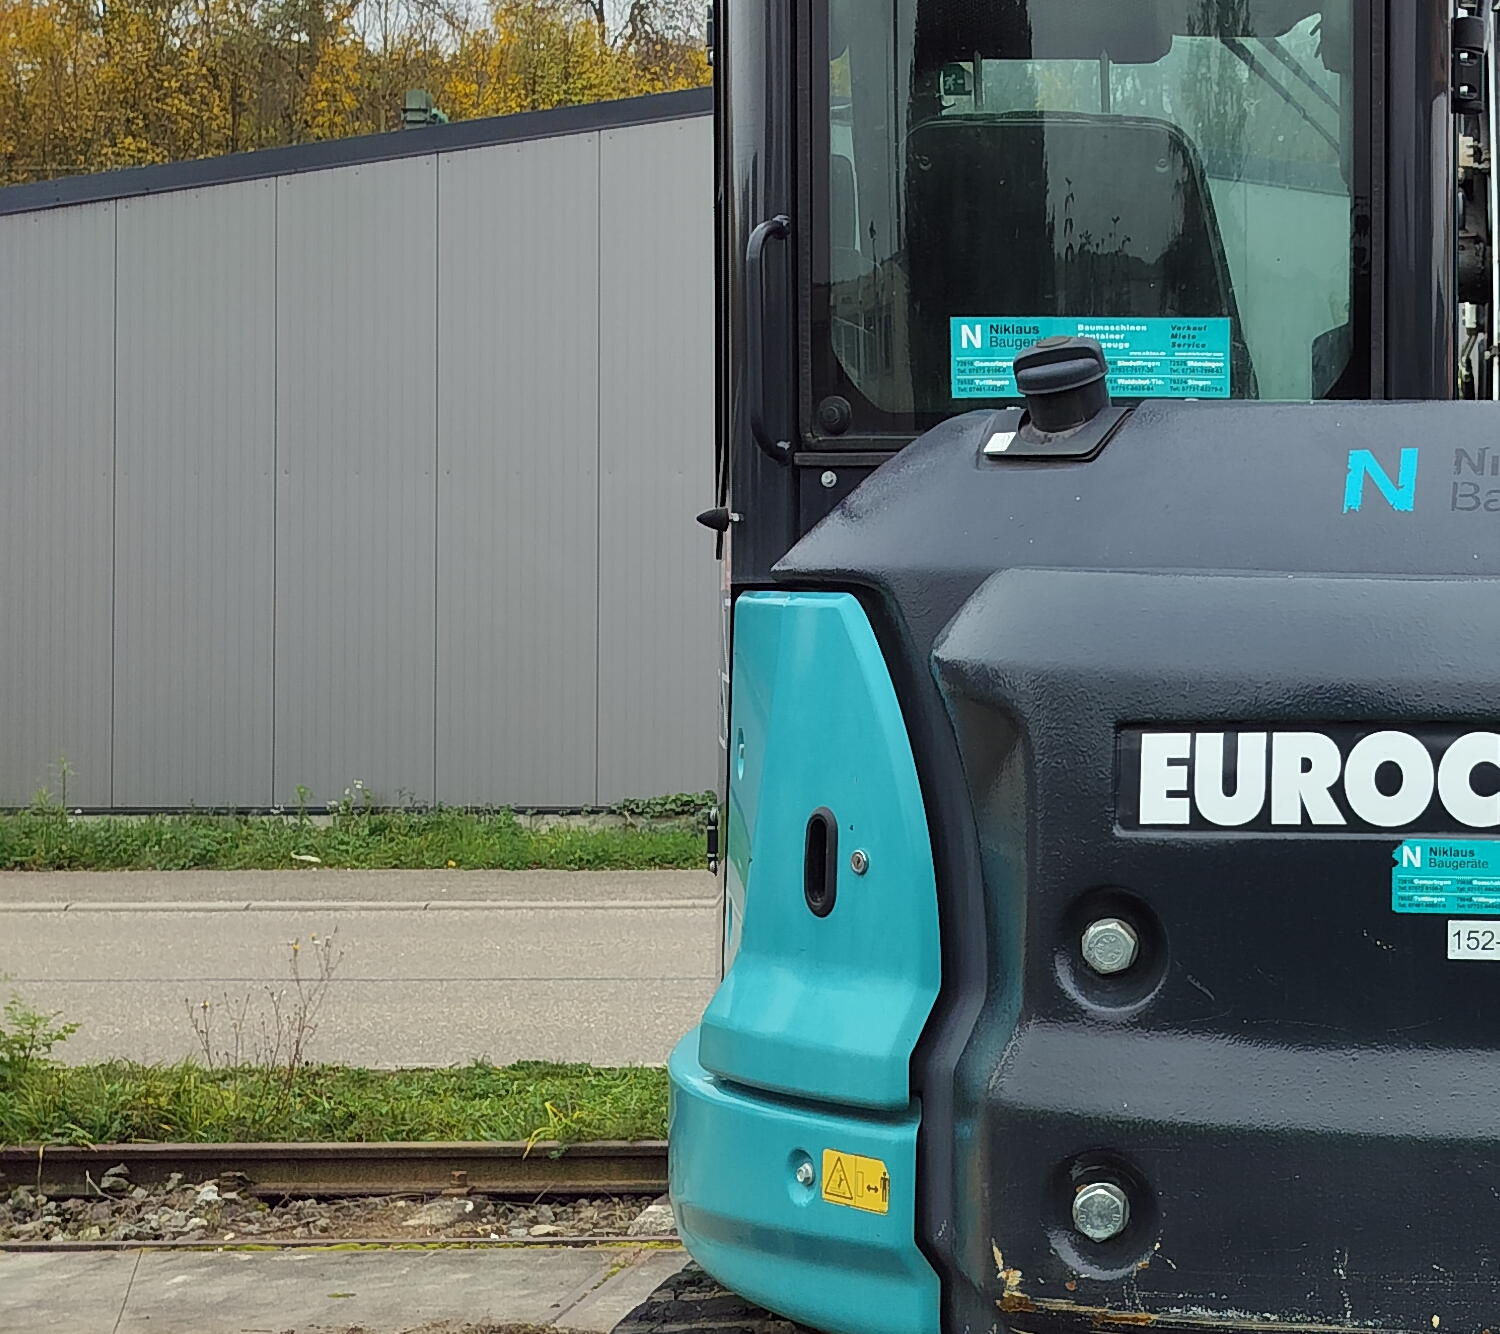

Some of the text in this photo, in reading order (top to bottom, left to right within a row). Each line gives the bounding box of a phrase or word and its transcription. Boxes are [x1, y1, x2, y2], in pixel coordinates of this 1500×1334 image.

[989, 324, 1040, 335] Niklaus
[1170, 324, 1208, 332] Verkauf
[961, 324, 982, 349] N
[1343, 447, 1418, 513] N
[1402, 846, 1422, 868] N
[1429, 846, 1475, 858] Niklaus
[1428, 857, 1489, 871] Baugeräte
